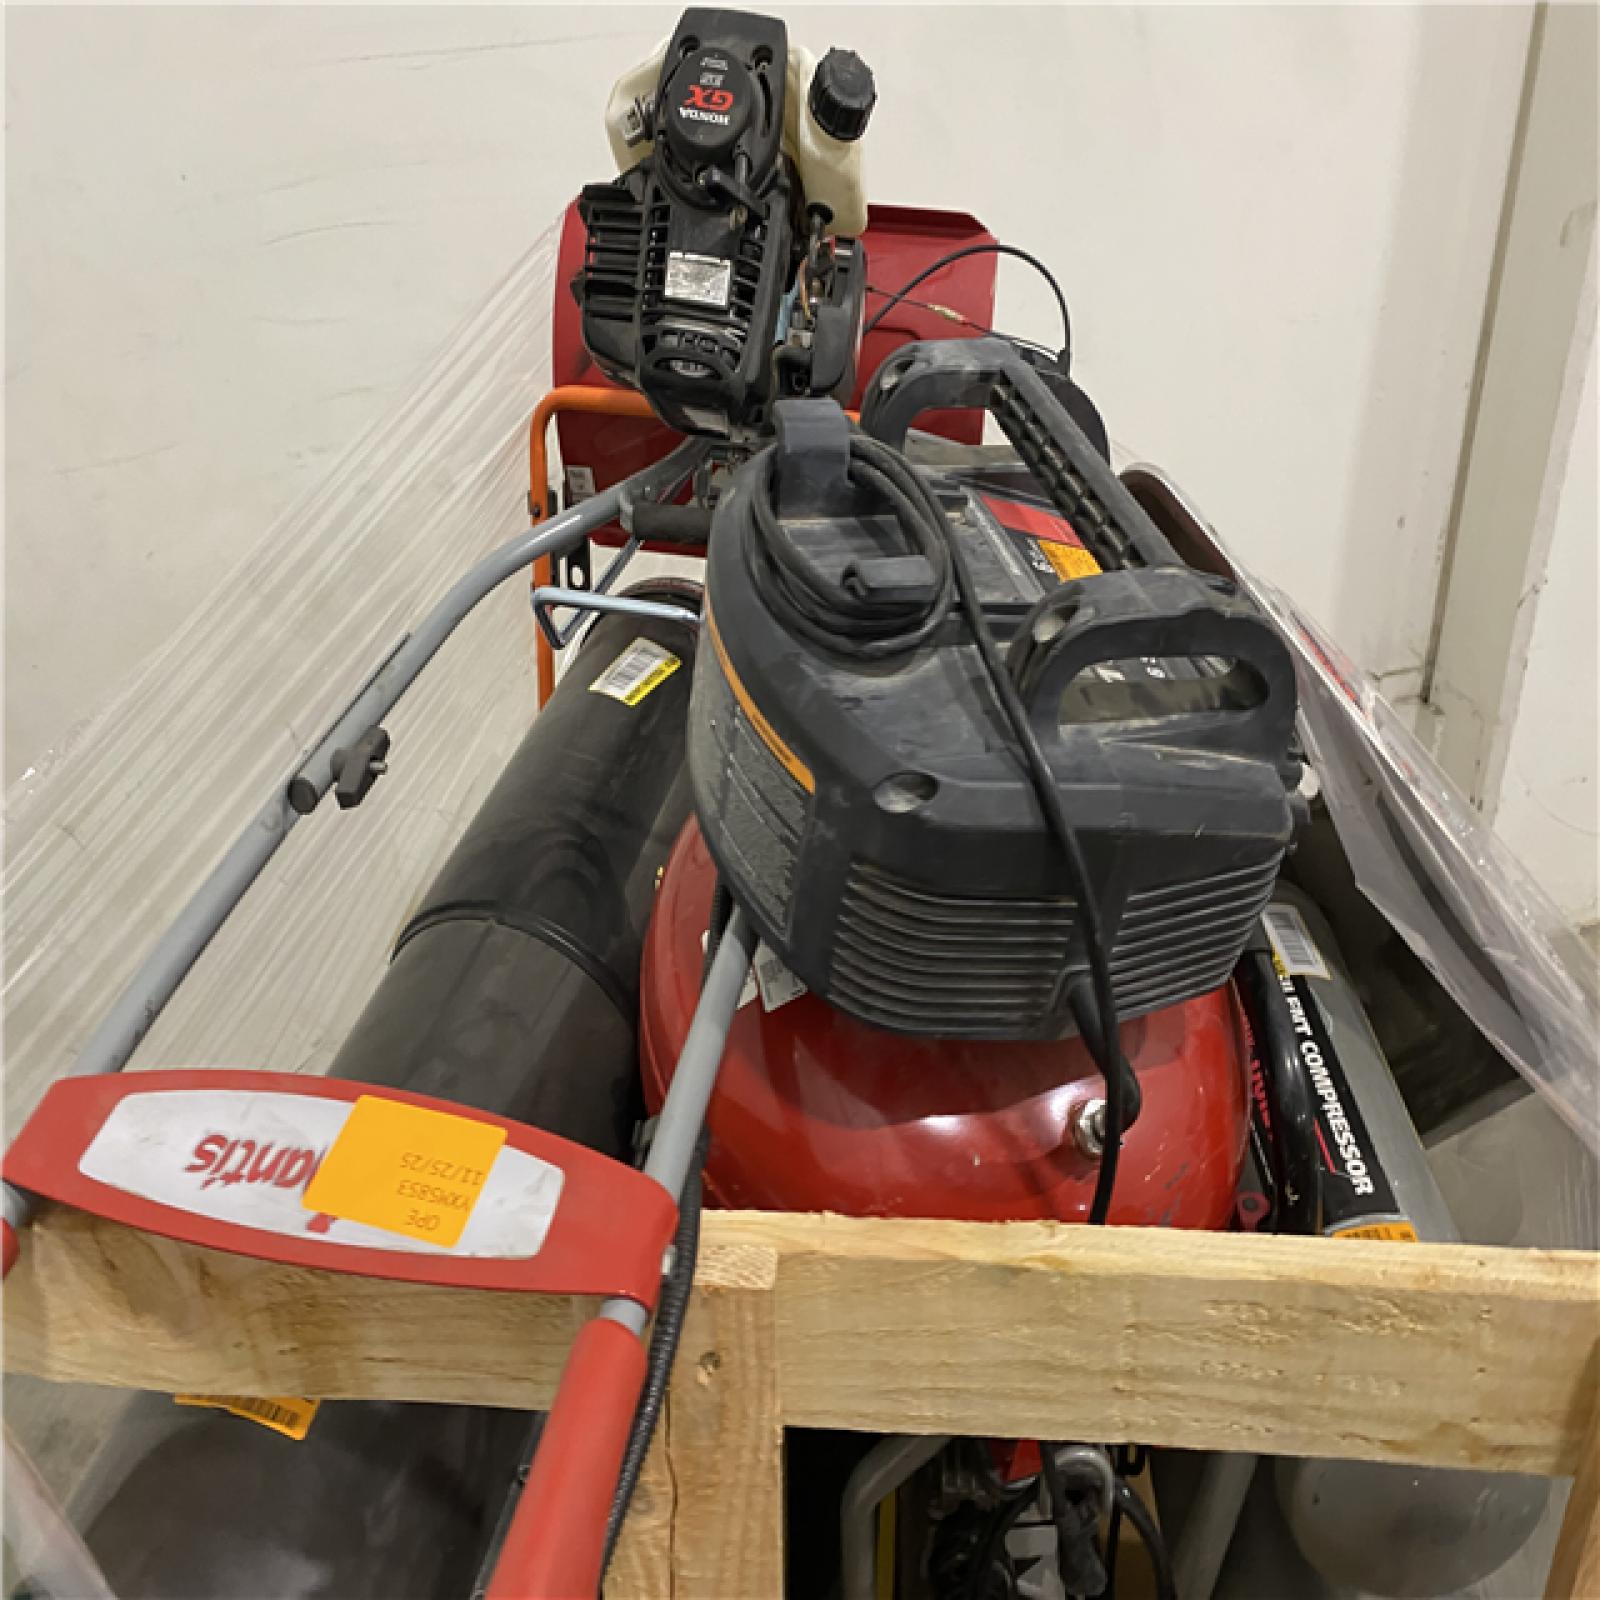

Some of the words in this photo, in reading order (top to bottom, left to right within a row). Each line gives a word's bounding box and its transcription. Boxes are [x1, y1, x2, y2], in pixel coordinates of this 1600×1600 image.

[683, 84, 734, 112] GX
[678, 106, 730, 126] HONDA
[1300, 1039, 1375, 1195] COMPRESSOR
[184, 1133, 334, 1212] antis
[399, 1151, 484, 1186] 11/25/25
[404, 1208, 440, 1231] OPE
